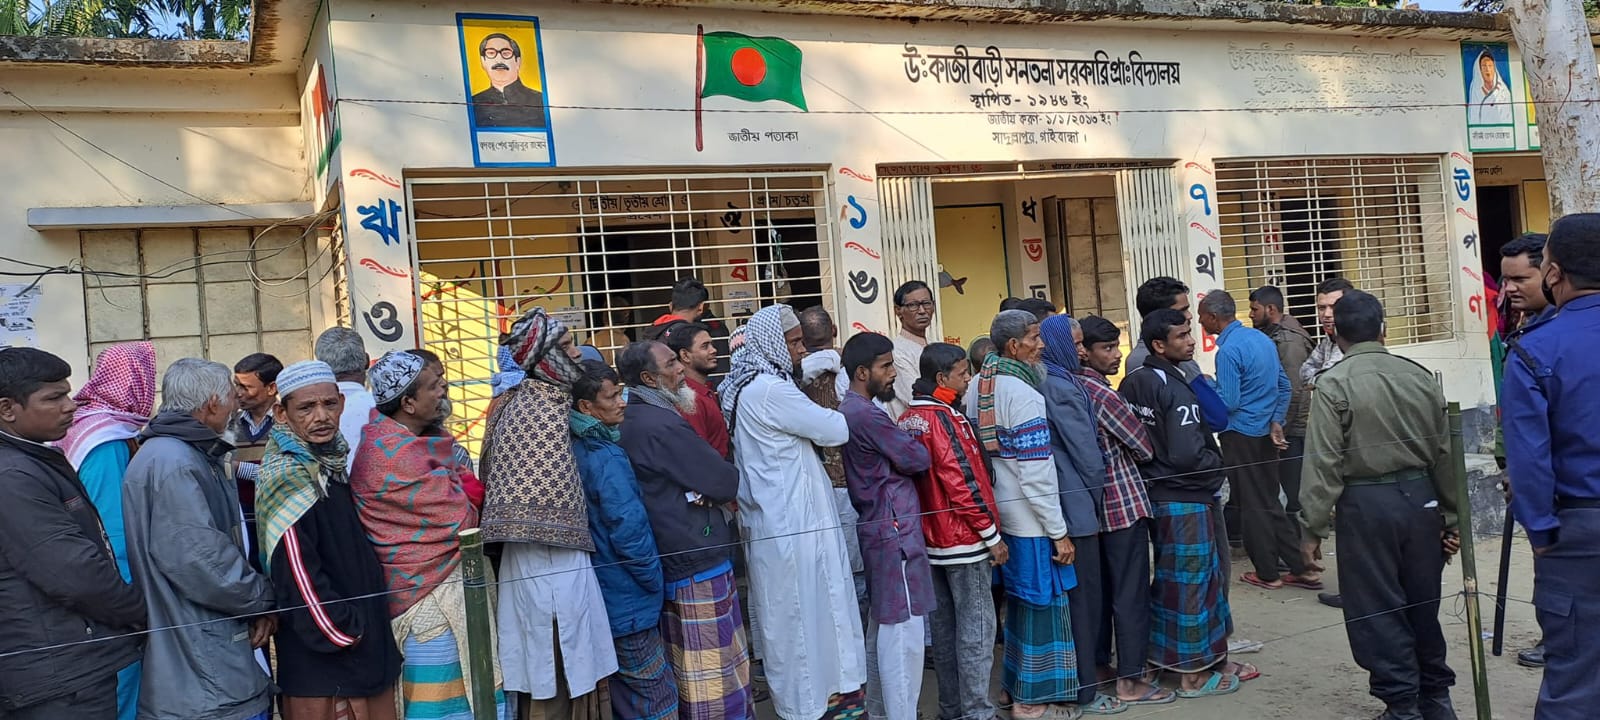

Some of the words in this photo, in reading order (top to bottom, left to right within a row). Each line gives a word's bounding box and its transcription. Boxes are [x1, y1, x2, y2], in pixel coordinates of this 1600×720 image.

[1004, 57, 1055, 85] সনতলা
[1056, 50, 1109, 86] সরকারি
[727, 128, 760, 143] জাতীয়
[764, 131, 799, 142] পতাকা
